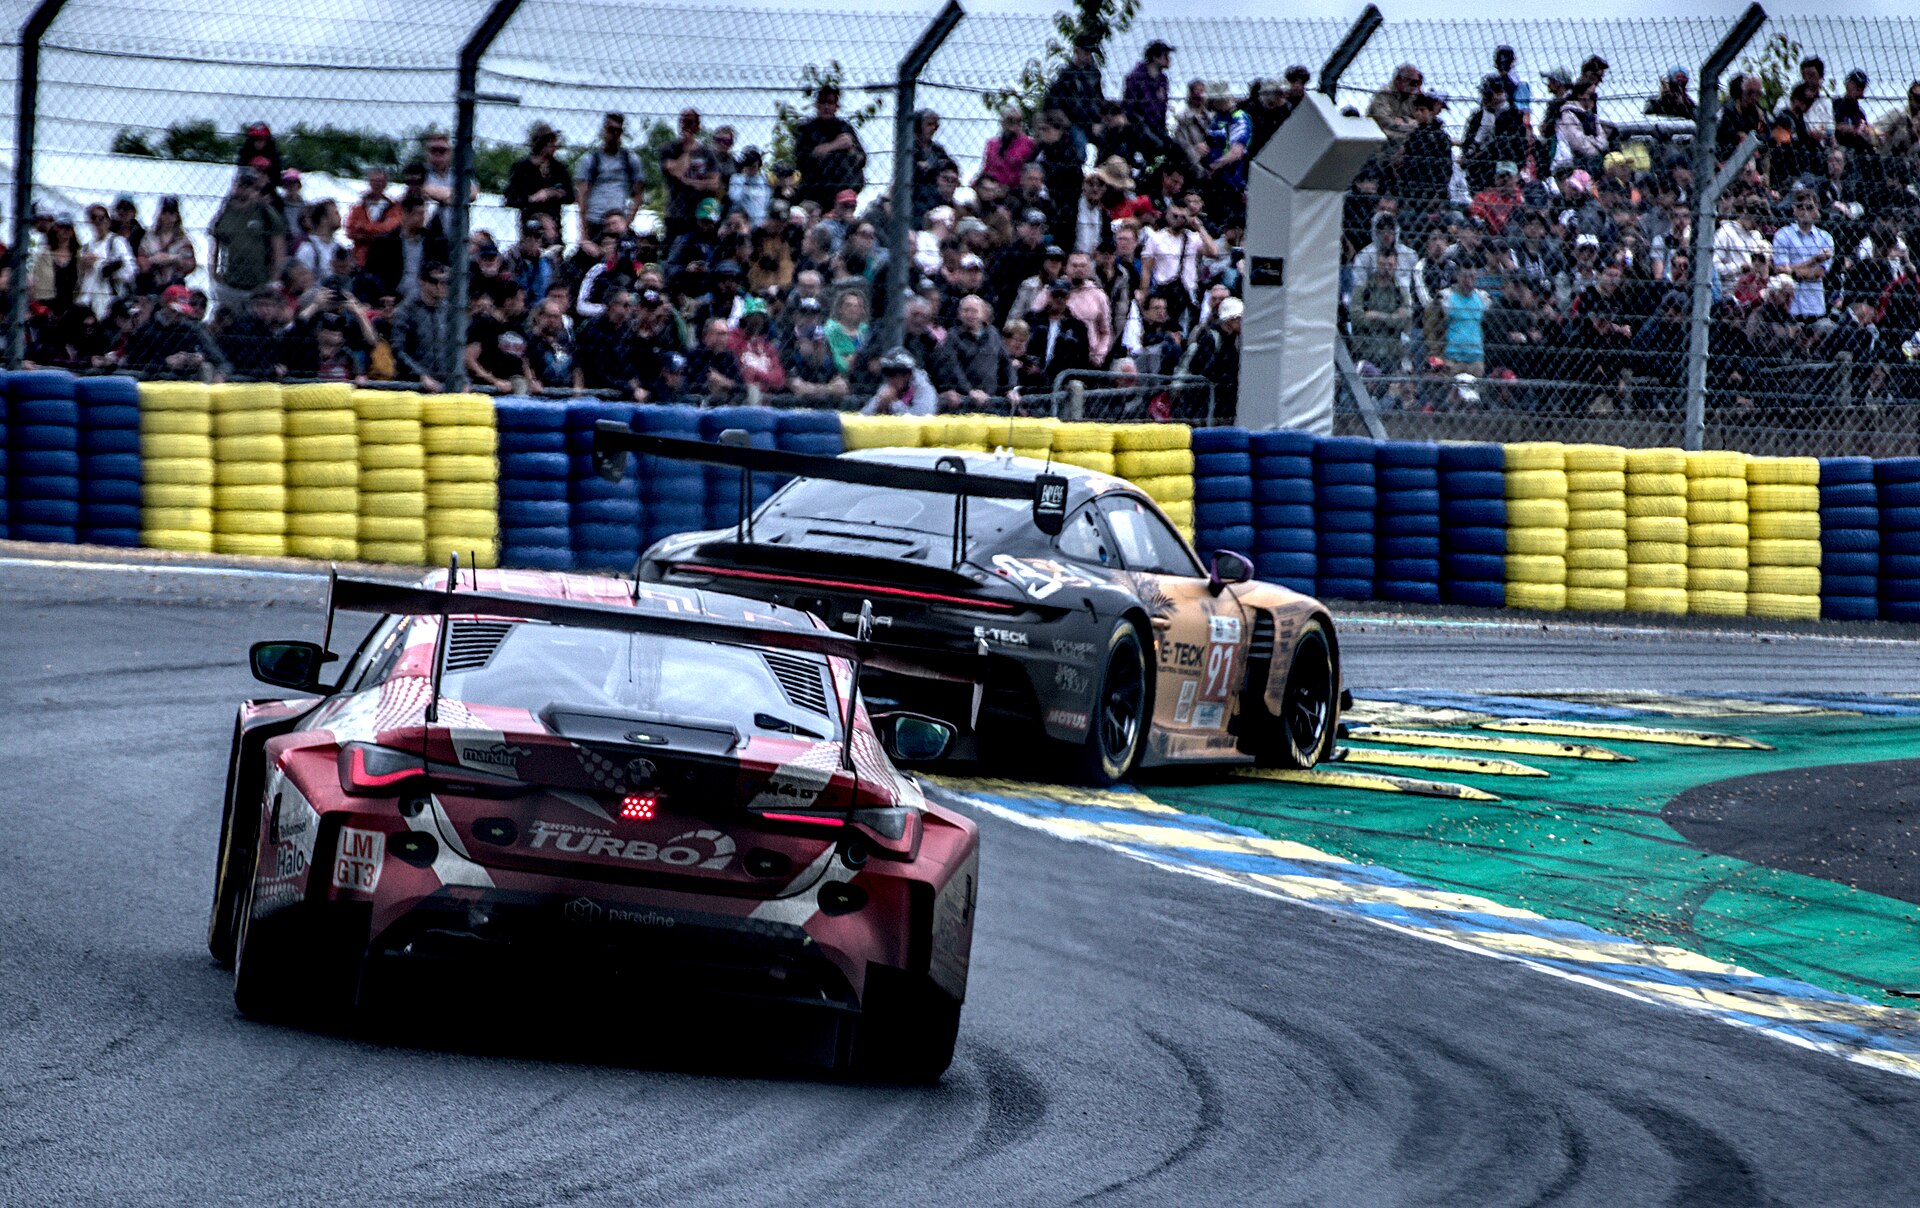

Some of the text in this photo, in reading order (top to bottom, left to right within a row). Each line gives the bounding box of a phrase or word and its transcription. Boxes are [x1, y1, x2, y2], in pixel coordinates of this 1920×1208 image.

[974, 625, 1029, 646] E-TECK
[1160, 640, 1206, 668] E-TECK
[1205, 644, 1235, 698] 91
[1047, 709, 1088, 730] MOTUL
[463, 747, 517, 768] mandiri
[343, 830, 373, 859] LM
[276, 844, 305, 877] Halo
[337, 859, 375, 887] GT3
[609, 908, 675, 928] paradine
